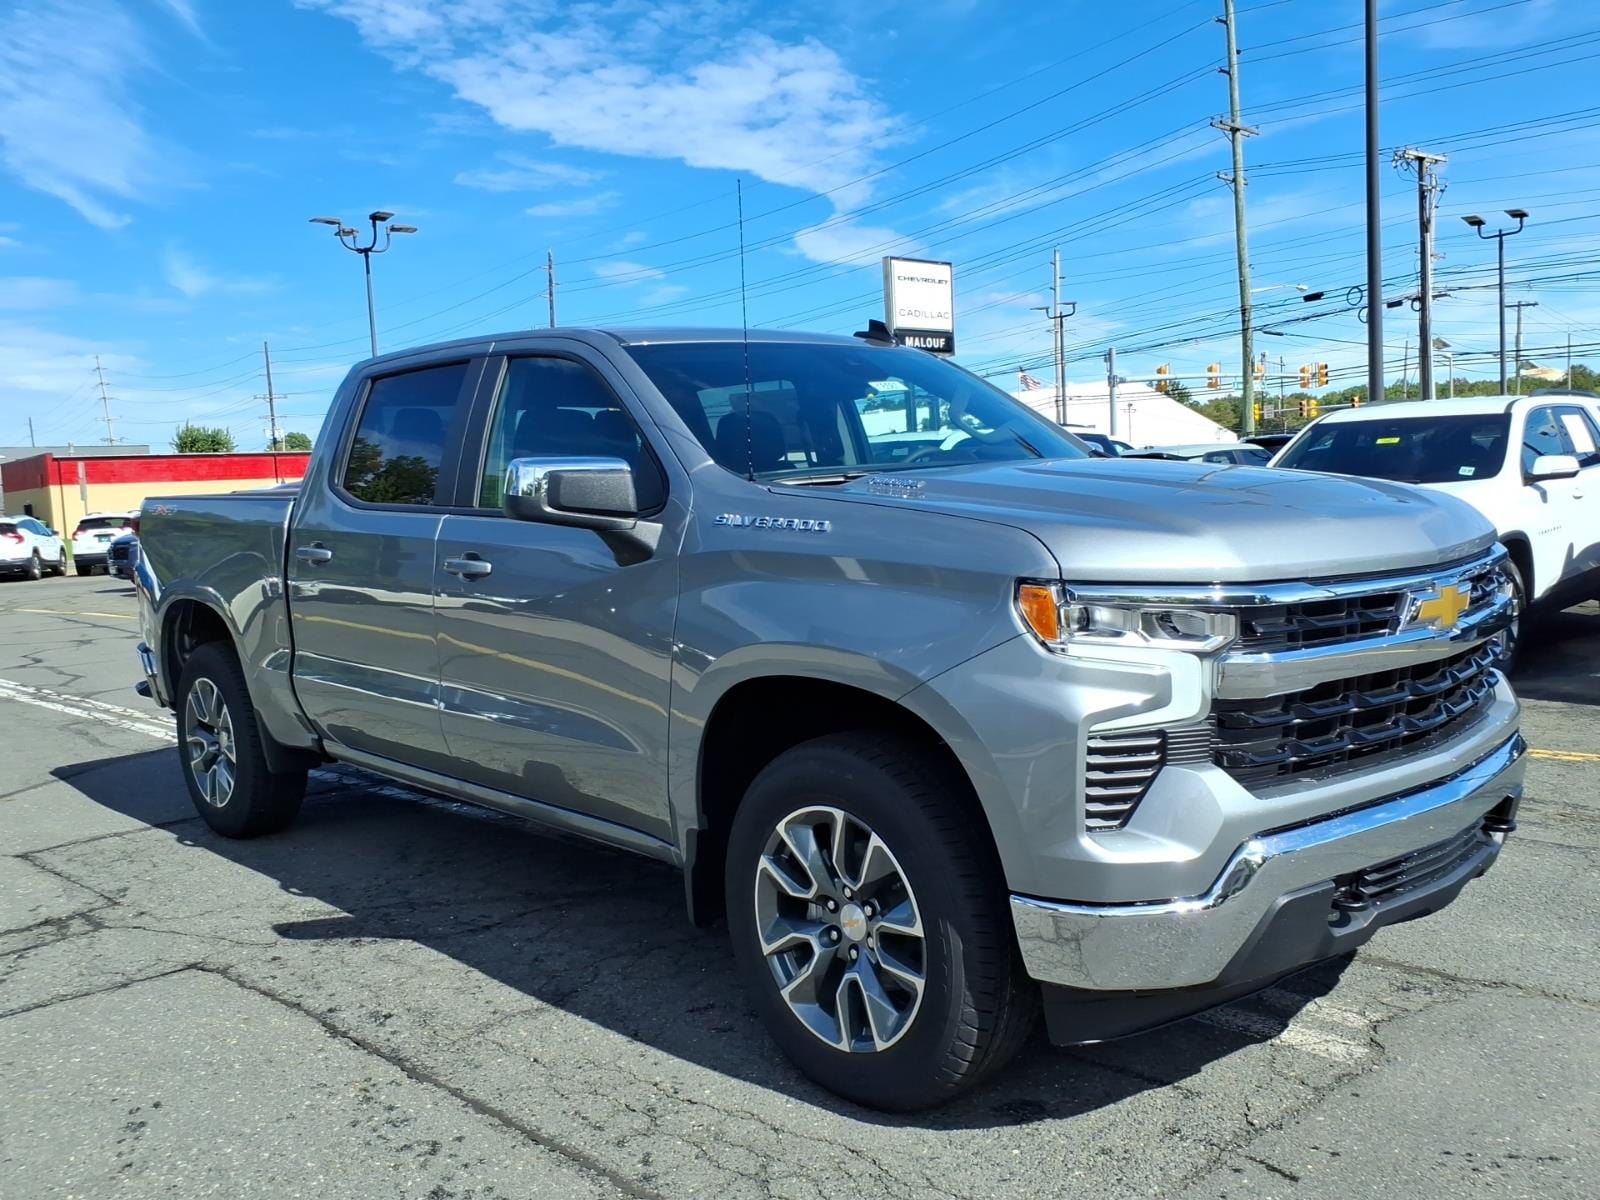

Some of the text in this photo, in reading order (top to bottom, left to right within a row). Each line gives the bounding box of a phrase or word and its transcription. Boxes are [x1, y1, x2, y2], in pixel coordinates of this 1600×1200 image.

[897, 275, 949, 285] CHEVROLET
[898, 308, 951, 320] CADILLAC
[904, 336, 946, 349] MALOUF
[713, 513, 832, 533] SILVERADO
